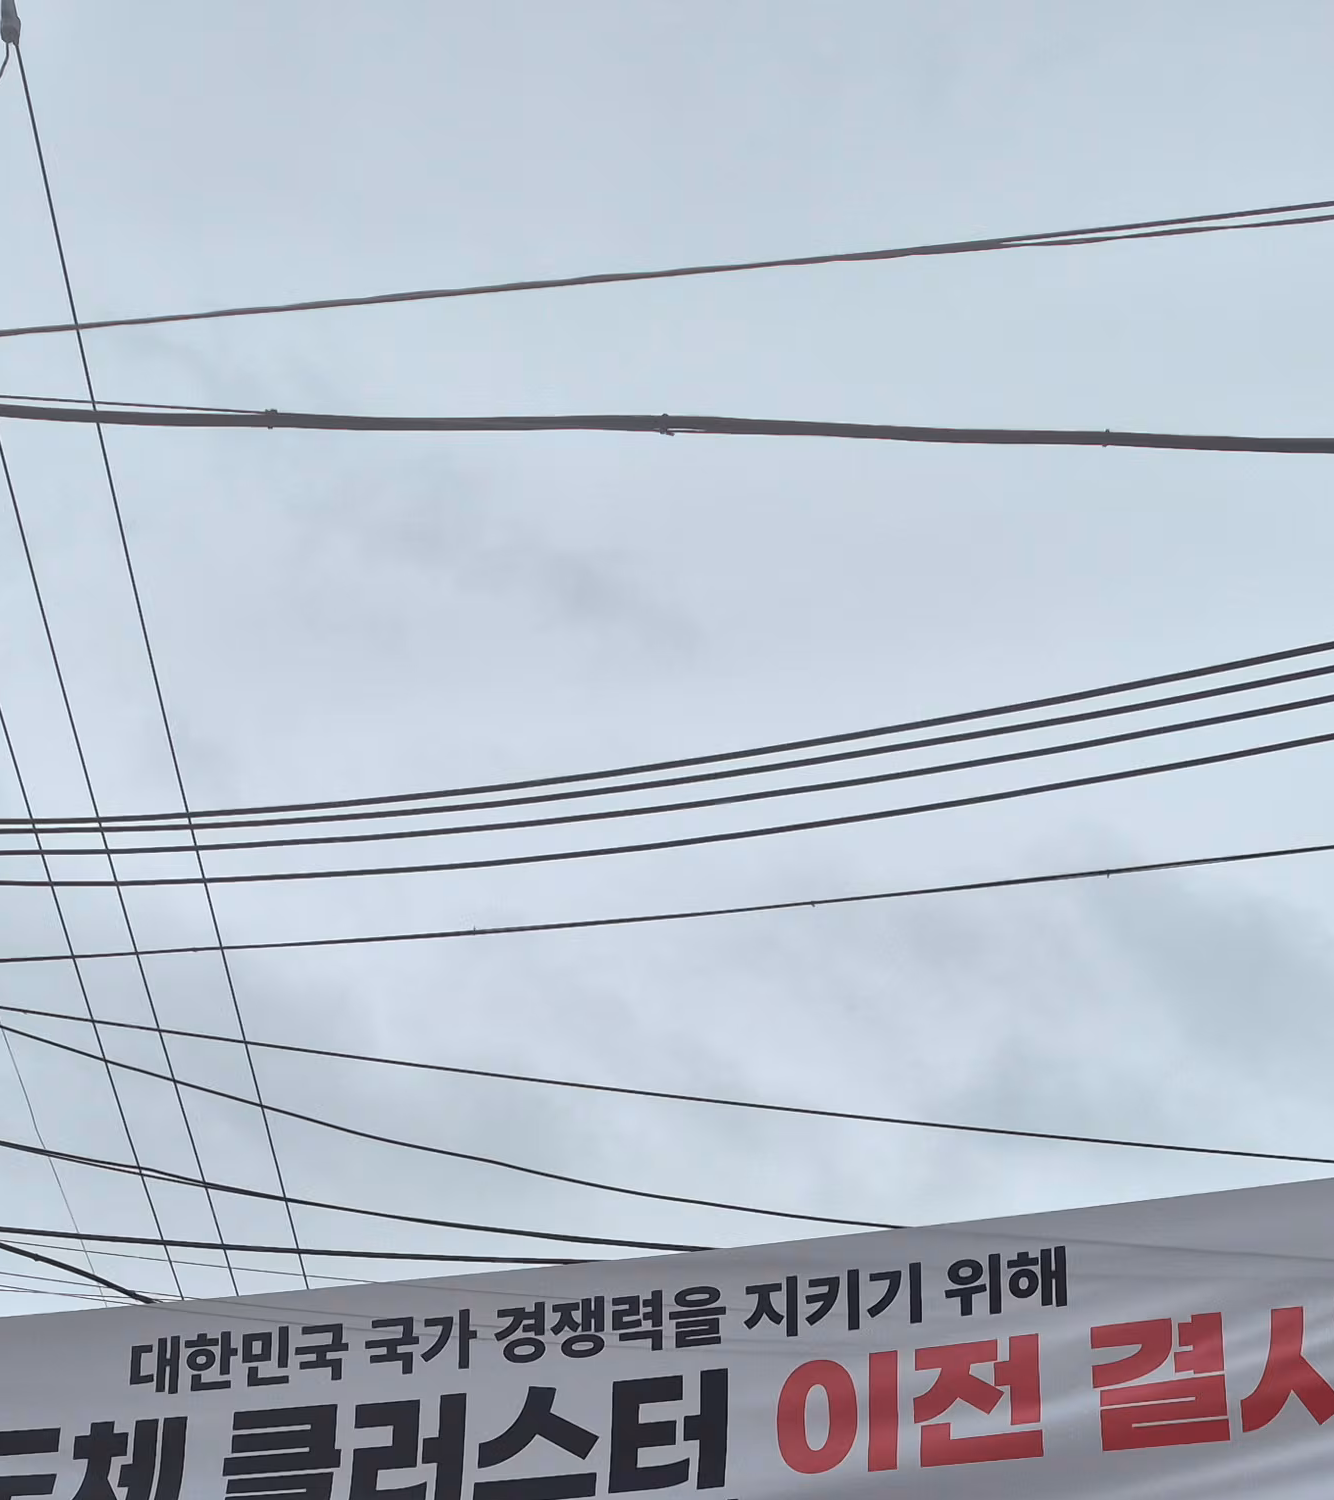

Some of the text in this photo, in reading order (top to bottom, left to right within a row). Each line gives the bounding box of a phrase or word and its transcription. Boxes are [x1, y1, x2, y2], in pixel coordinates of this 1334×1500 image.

[128, 1244, 1070, 1395] 대한민국 국가 경쟁력을 지키기 위해
[775, 1332, 1045, 1475] 이전
